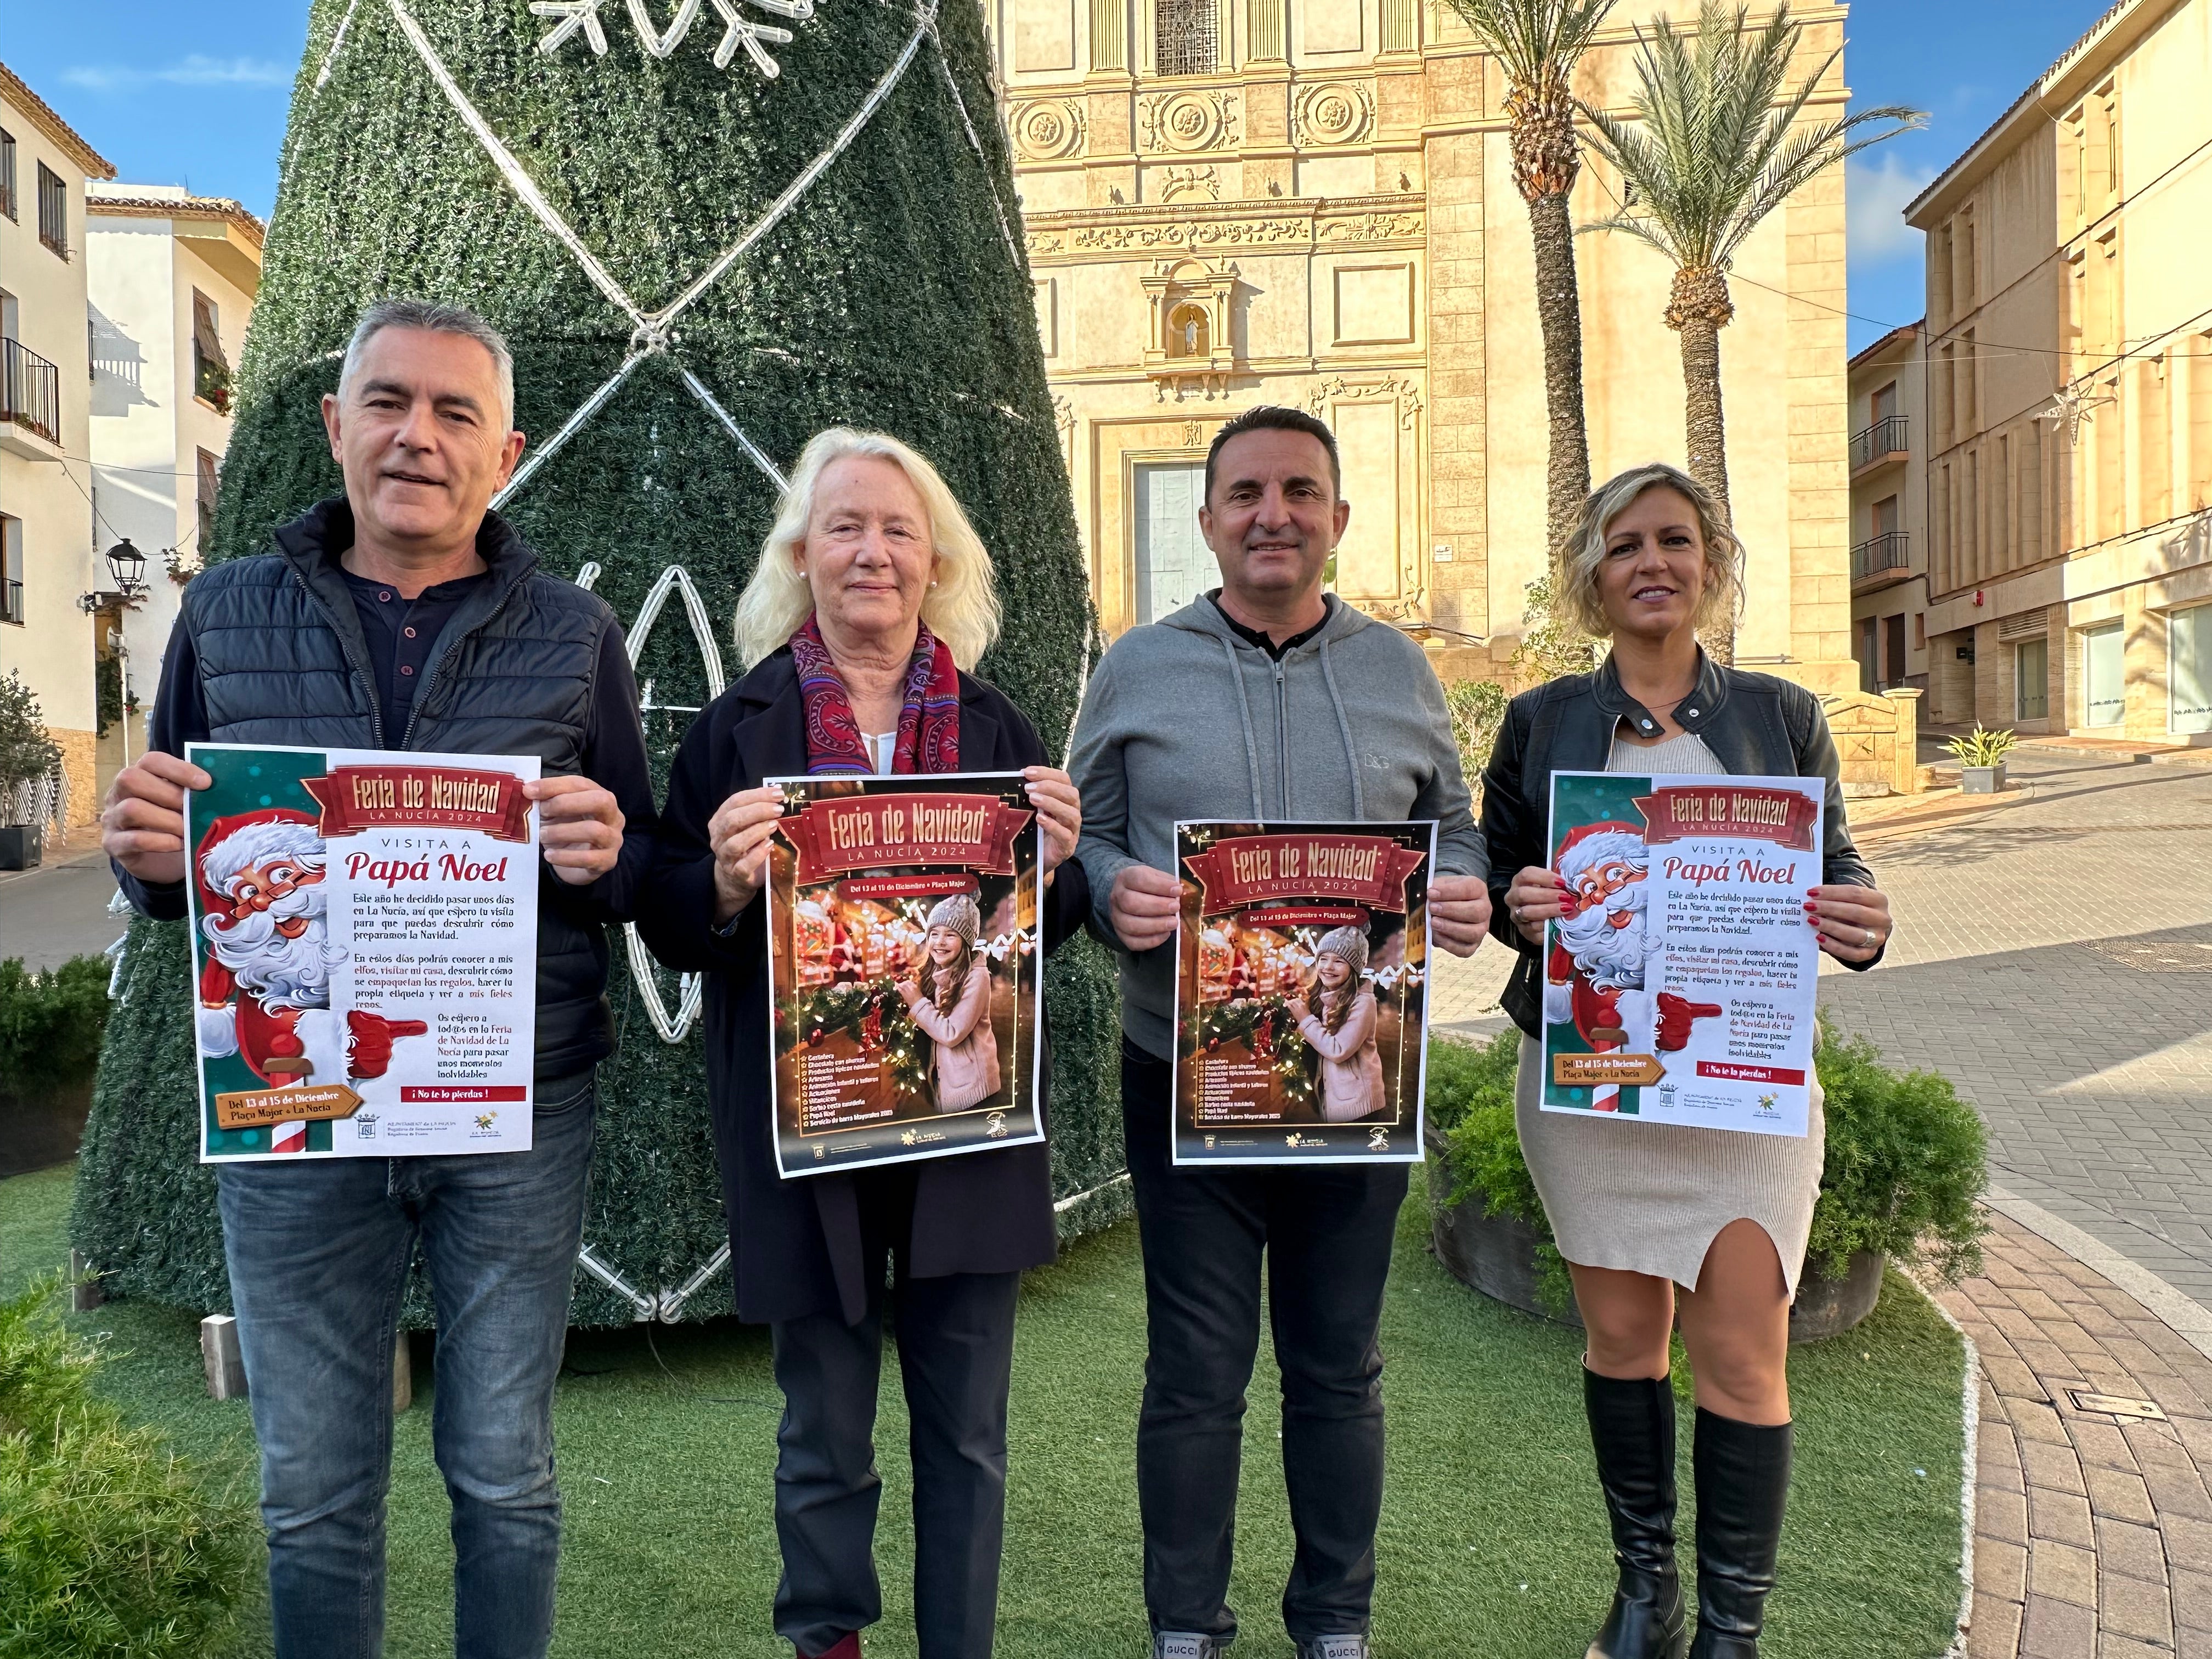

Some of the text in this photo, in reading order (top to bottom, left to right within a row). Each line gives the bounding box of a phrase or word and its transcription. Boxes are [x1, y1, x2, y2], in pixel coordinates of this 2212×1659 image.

[352, 774, 500, 814] Feria de Navidad
[395, 810, 439, 820] NUCÍA
[449, 813, 481, 822] 2024
[1670, 793, 1790, 826] Feria de Navidad
[828, 803, 985, 850] Feria de Navidad
[382, 838, 471, 849] VISITA A
[1692, 845, 1746, 855] VISITA
[848, 845, 965, 861] LA NUCÍA 2024
[345, 852, 508, 889] Papá Noel
[1231, 842, 1378, 885] Feria de Navidad
[1663, 856, 1796, 888] Papá Noel
[1249, 880, 1357, 894] LA NUCÍA 2024
[354, 930, 459, 942] preparamos la Navidad.
[438, 1036, 509, 1045] de Navidad de La
[229, 1091, 339, 1109] Del 13 al 15 de Diciembre
[418, 1090, 429, 1098] No
[432, 1090, 439, 1098] te
[442, 1090, 449, 1098] lo
[452, 1089, 483, 1101] pierdas
[1167, 1646, 1197, 1655] GUCCI
[1328, 1649, 1358, 1658] GUCCI
